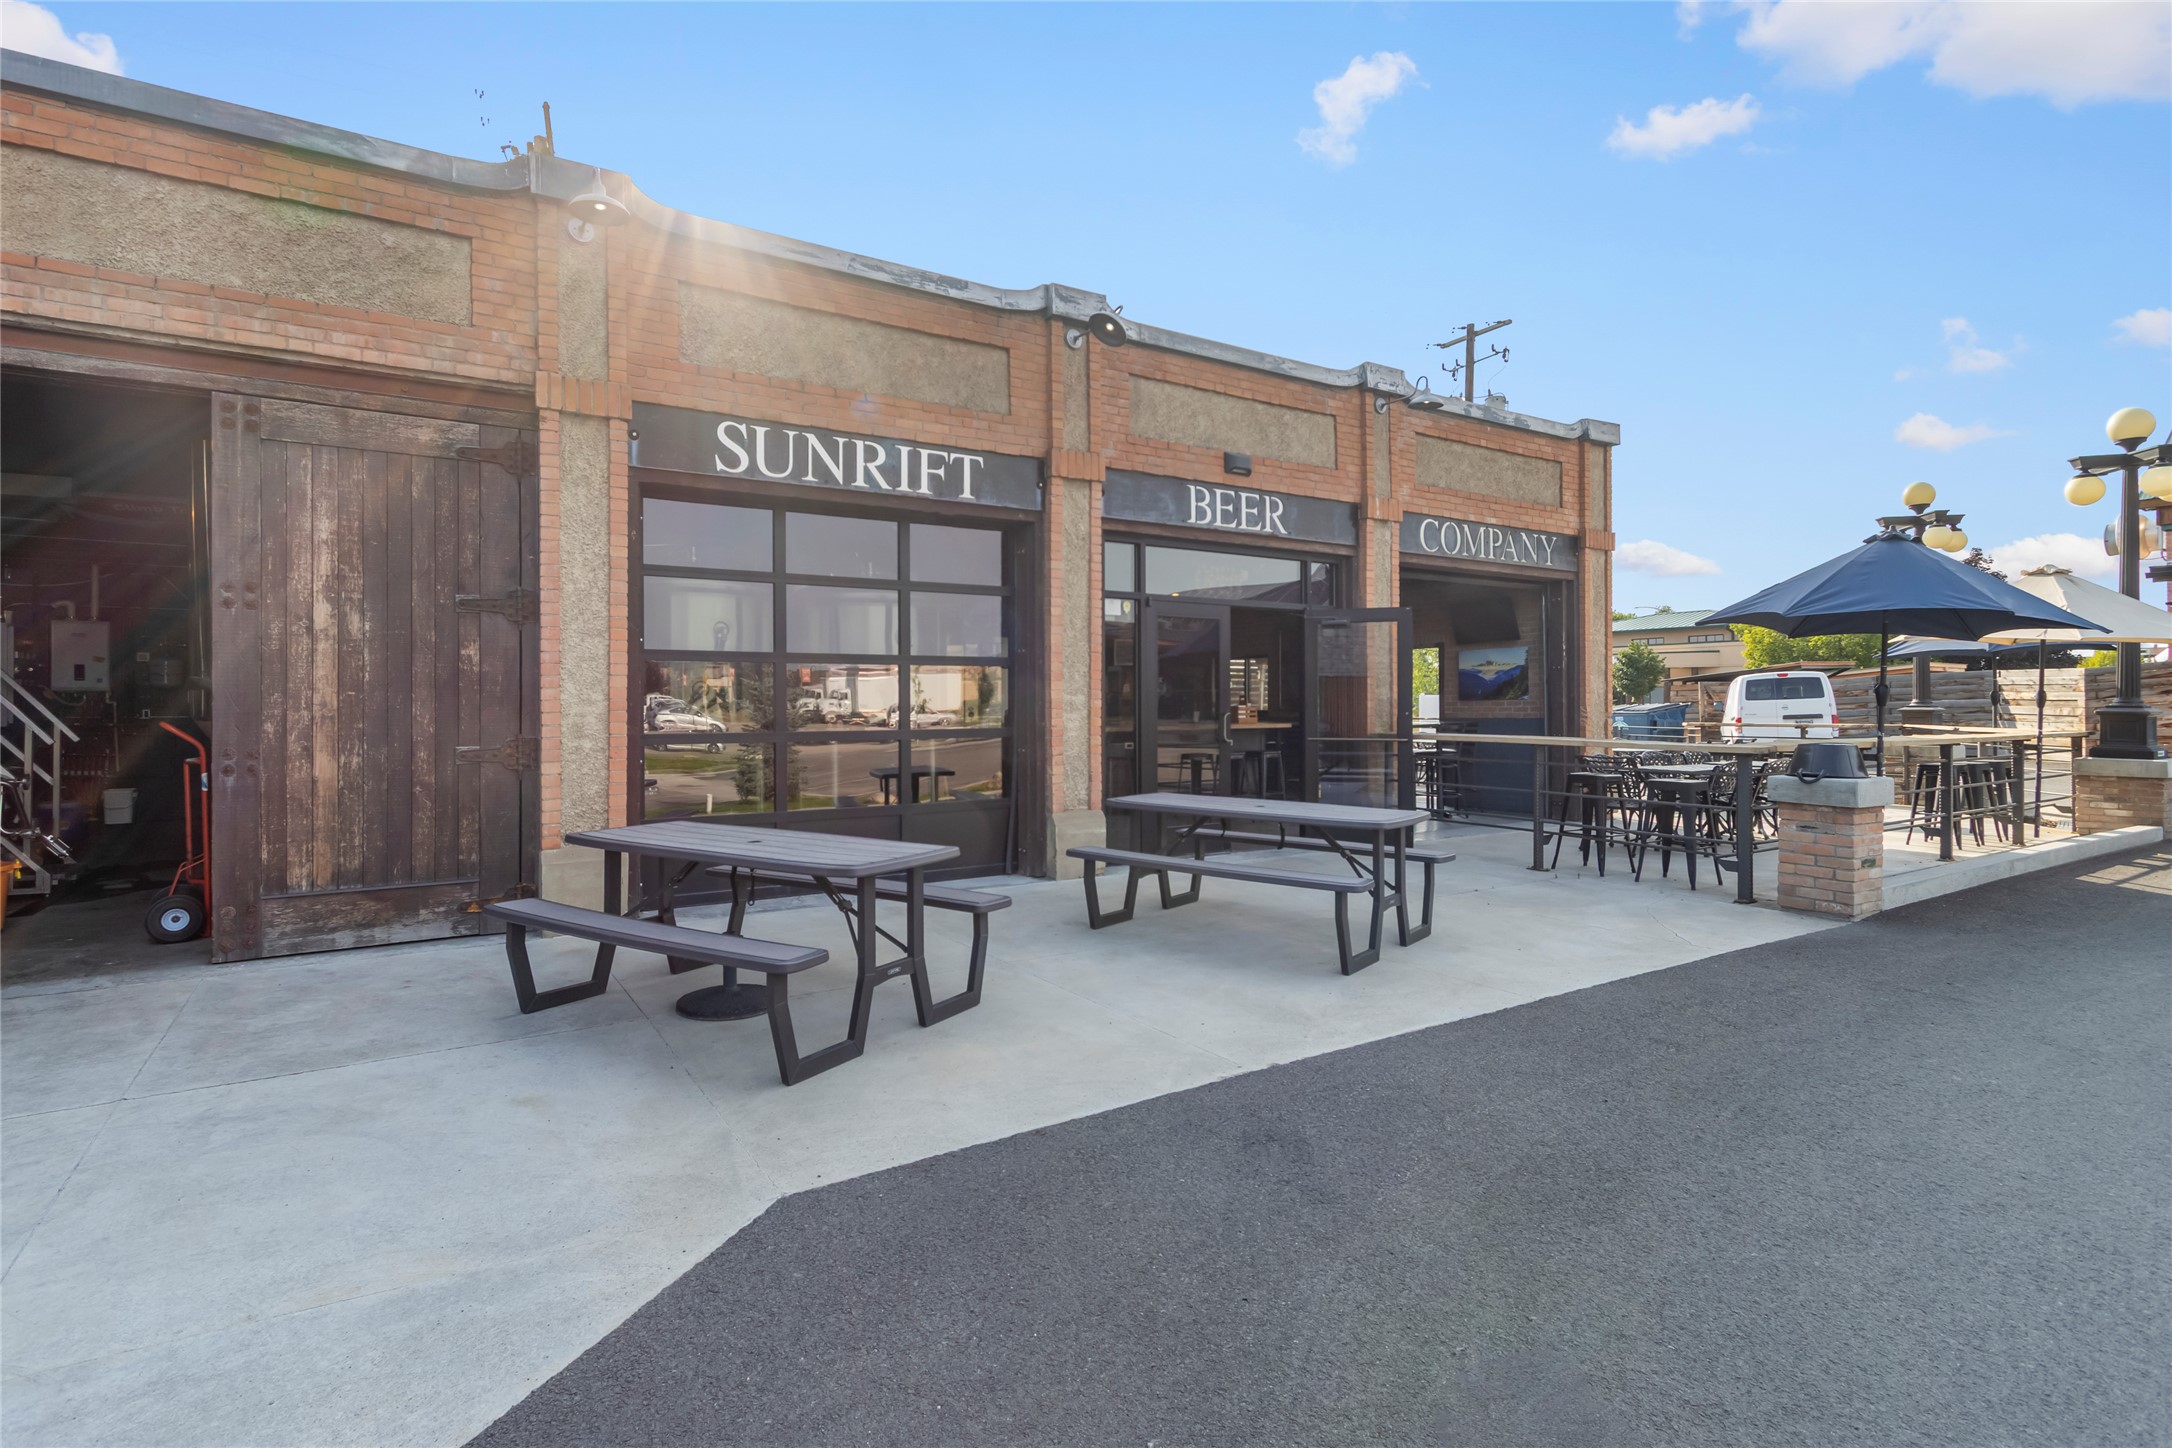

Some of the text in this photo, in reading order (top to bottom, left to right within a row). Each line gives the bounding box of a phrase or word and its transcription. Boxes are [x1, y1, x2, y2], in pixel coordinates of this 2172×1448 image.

[715, 421, 984, 499] SUNRIFT
[1186, 484, 1288, 535] BEER
[1419, 519, 1558, 567] COMPANY
